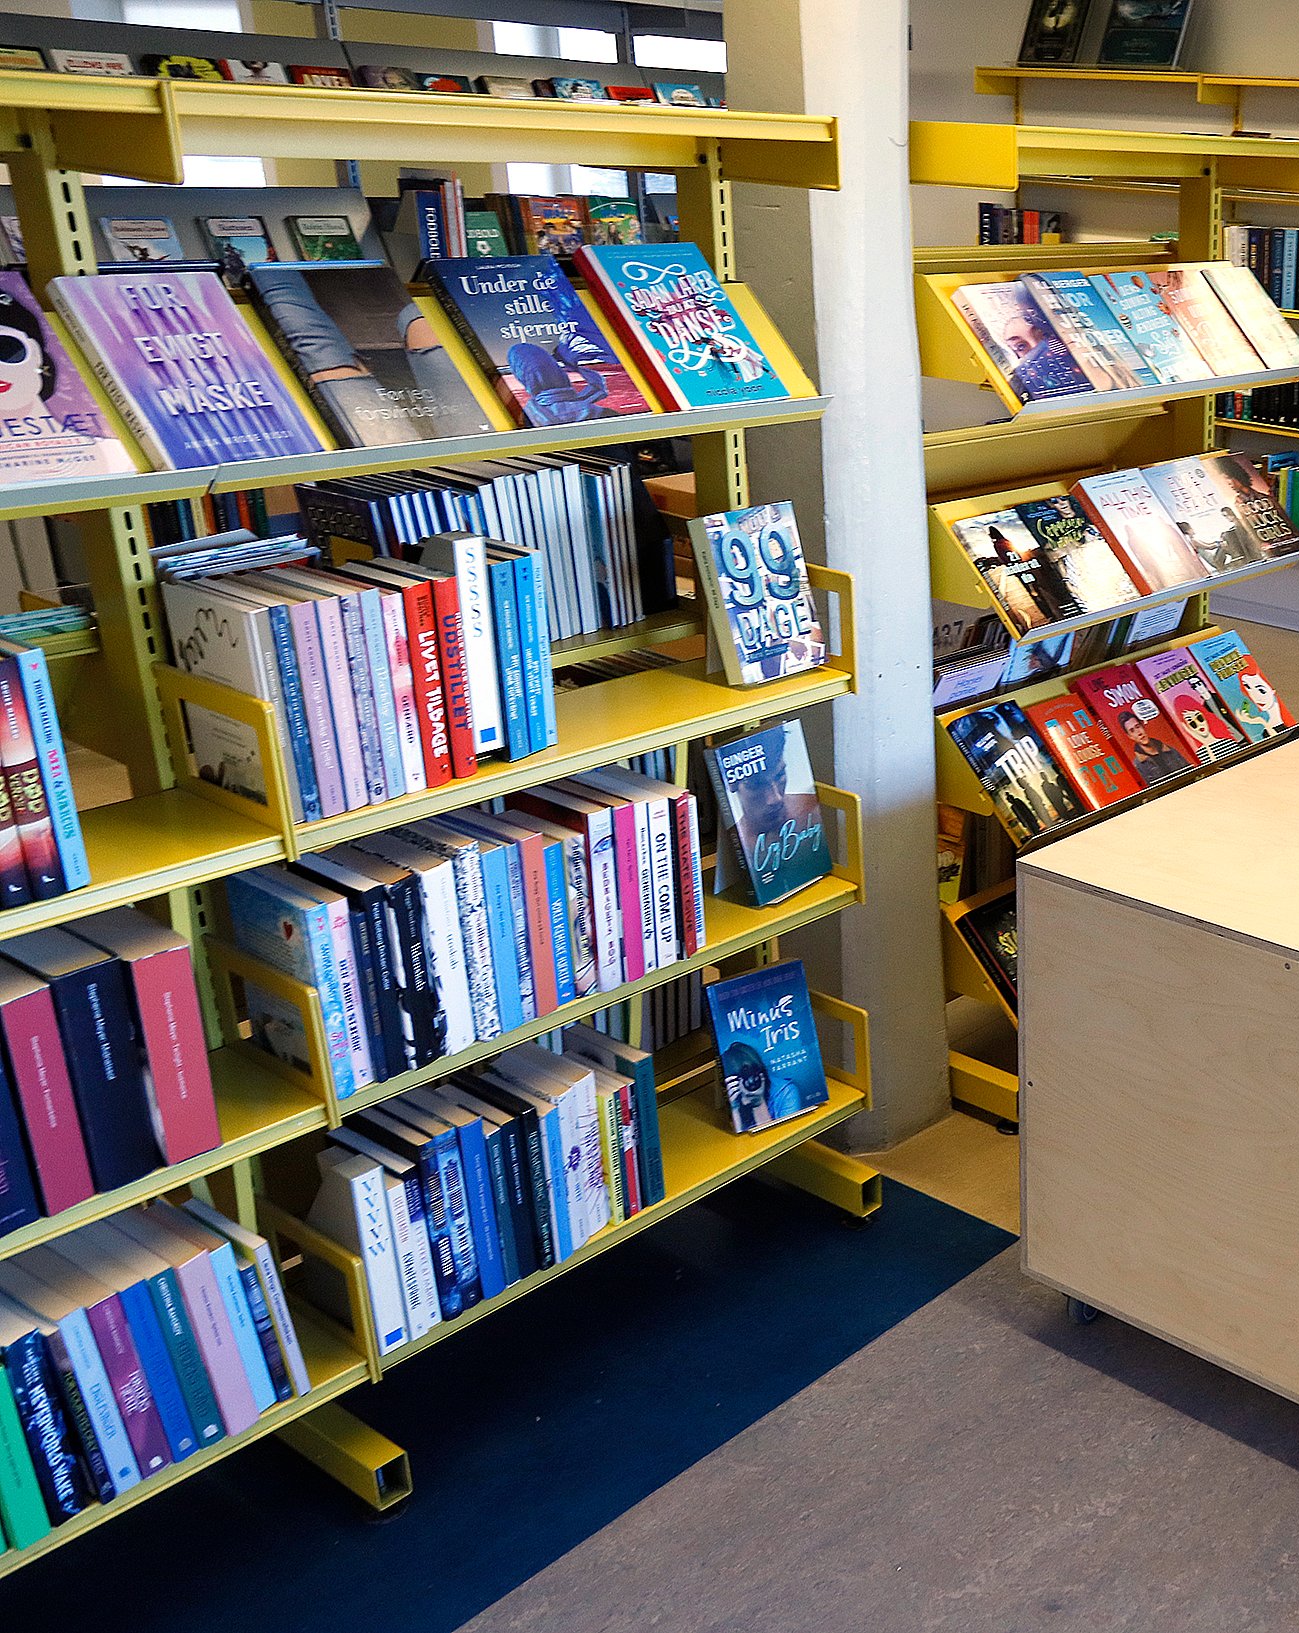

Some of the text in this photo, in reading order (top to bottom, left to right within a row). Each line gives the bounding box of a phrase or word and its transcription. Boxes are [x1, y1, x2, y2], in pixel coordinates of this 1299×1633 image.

[119, 283, 188, 310] FOR
[458, 271, 558, 295] Under de
[505, 295, 555, 316] stille
[133, 331, 229, 363] EVIGT
[500, 320, 578, 343] stjerner
[158, 377, 273, 416] MÅSKE
[721, 523, 805, 608] 99
[736, 598, 812, 652] DAGE
[442, 614, 469, 731] UDSTILLET
[417, 629, 449, 759] LIVET TILBAGE
[44, 747, 63, 778] MIA
[722, 744, 766, 769] GINGER
[726, 756, 767, 785] SCOTT
[994, 735, 1046, 788] TRIP
[50, 788, 78, 840] MARCUS
[678, 812, 687, 837] THE
[679, 843, 690, 879] HATE
[655, 832, 672, 943] ON THE COME UP
[683, 899, 693, 932] GIVE
[727, 994, 794, 1032] Minus
[760, 1020, 801, 1053] Iris
[22, 1381, 78, 1501] NEVERWORLD WAKE
